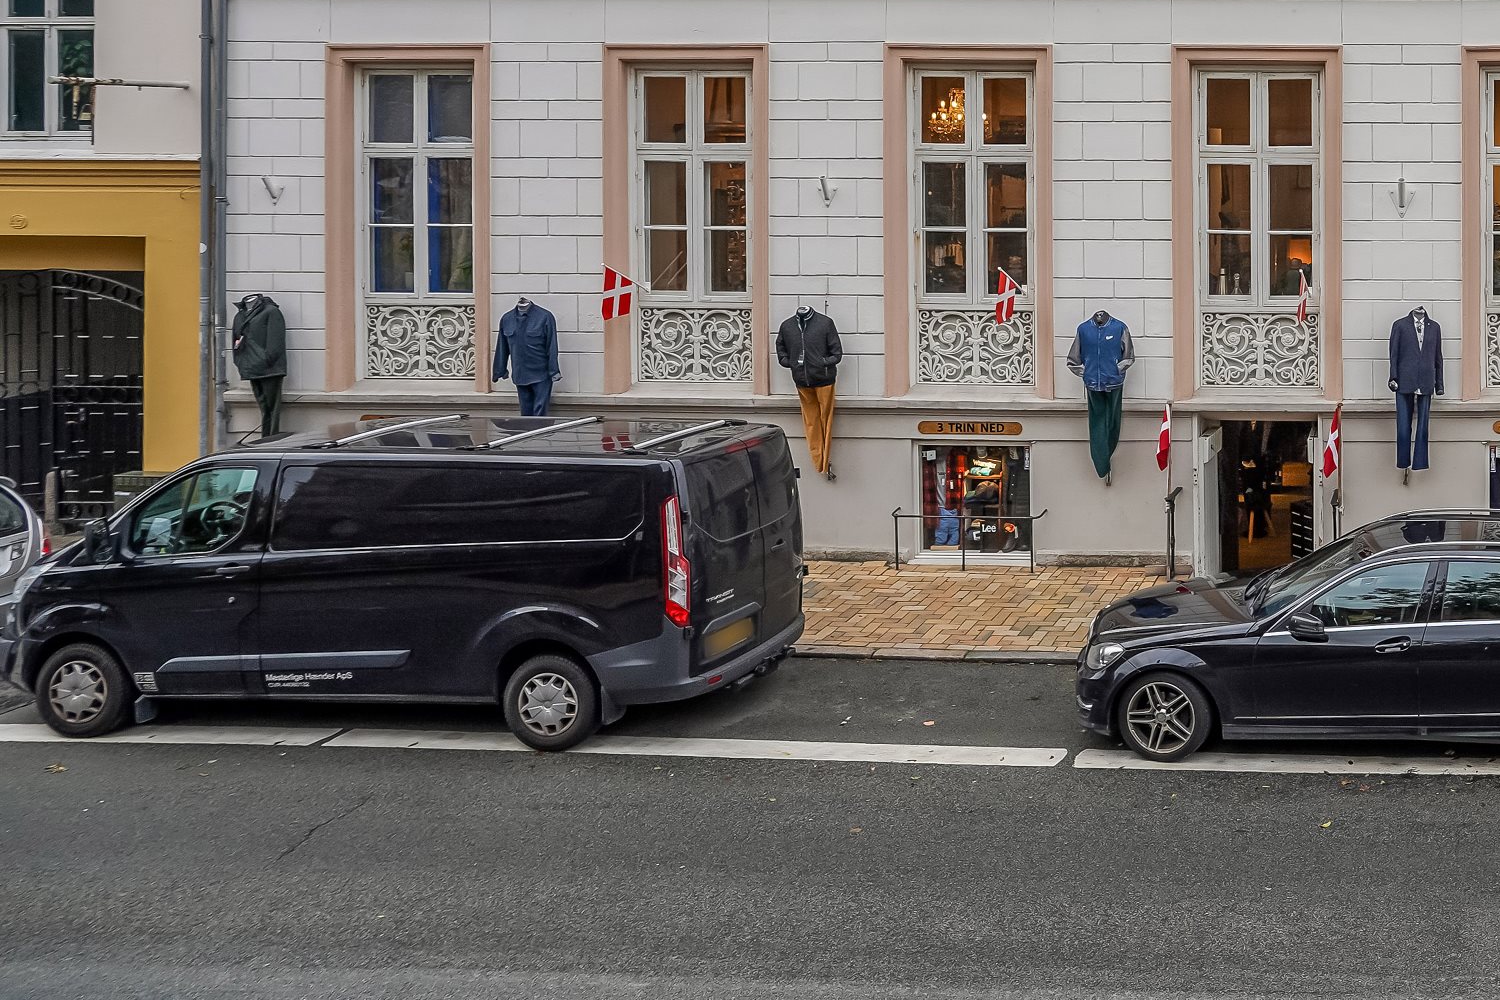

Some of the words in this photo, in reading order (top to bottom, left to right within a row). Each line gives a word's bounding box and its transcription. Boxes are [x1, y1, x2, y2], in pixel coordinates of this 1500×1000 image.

[937, 423, 944, 432] 3
[948, 423, 975, 432] TRIN
[980, 423, 1004, 432] NED
[981, 524, 997, 533] Lee
